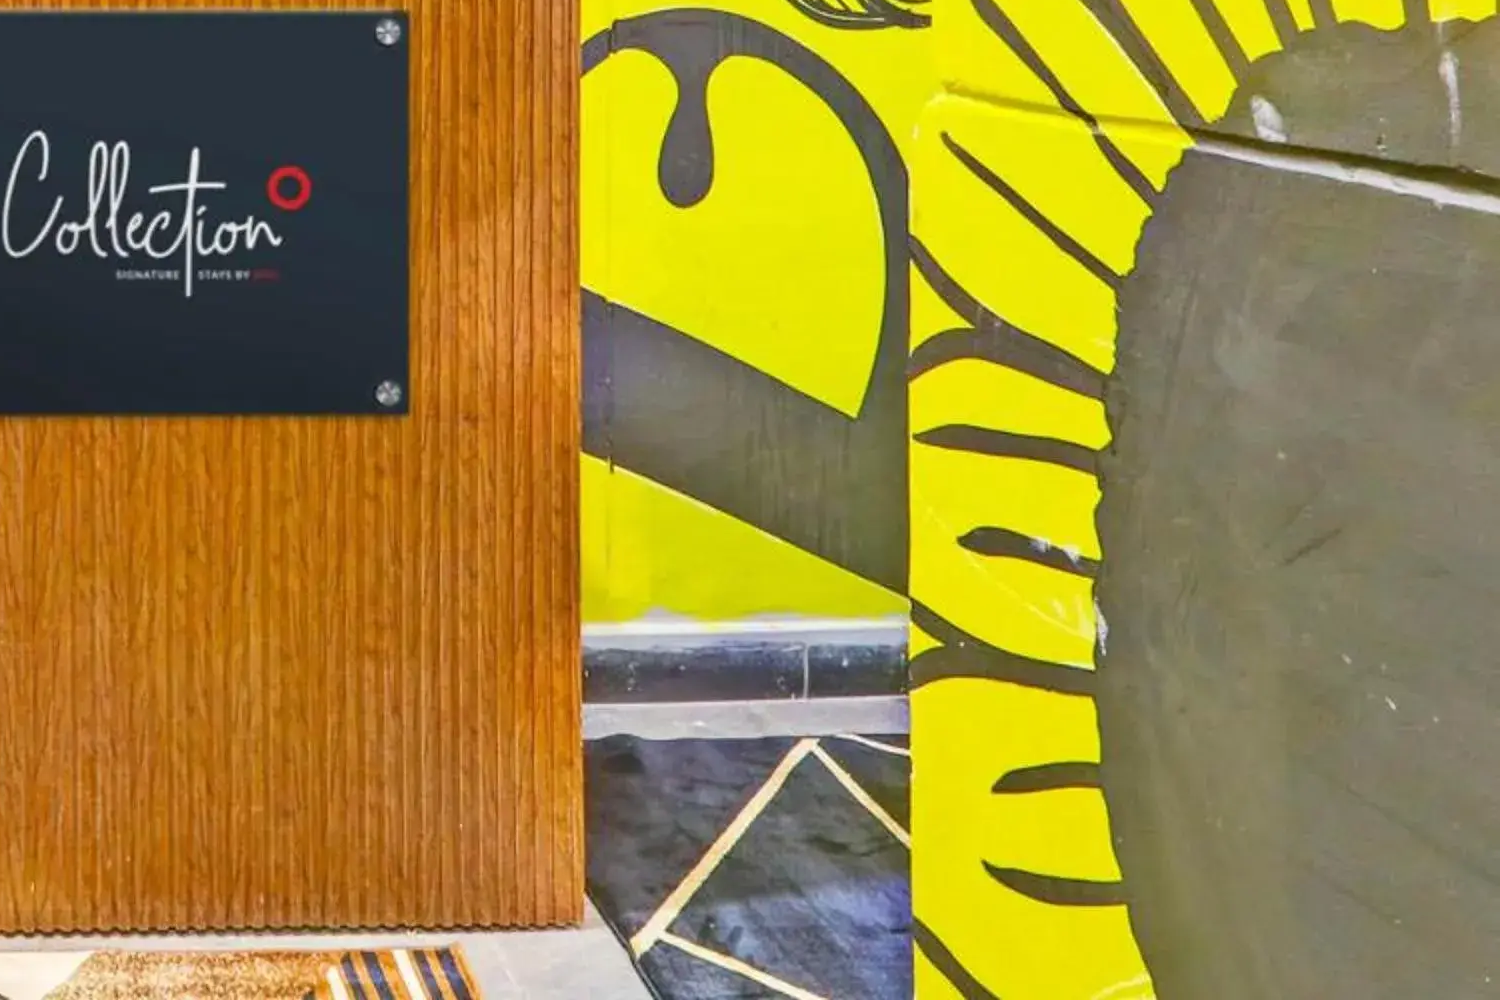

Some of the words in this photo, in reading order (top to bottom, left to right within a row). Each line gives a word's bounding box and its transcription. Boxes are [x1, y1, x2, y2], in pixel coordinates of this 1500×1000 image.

[2, 130, 283, 297] Collection
[115, 269, 180, 281] SIGNATURE
[197, 269, 233, 281] STAYS
[234, 269, 251, 281] BY
